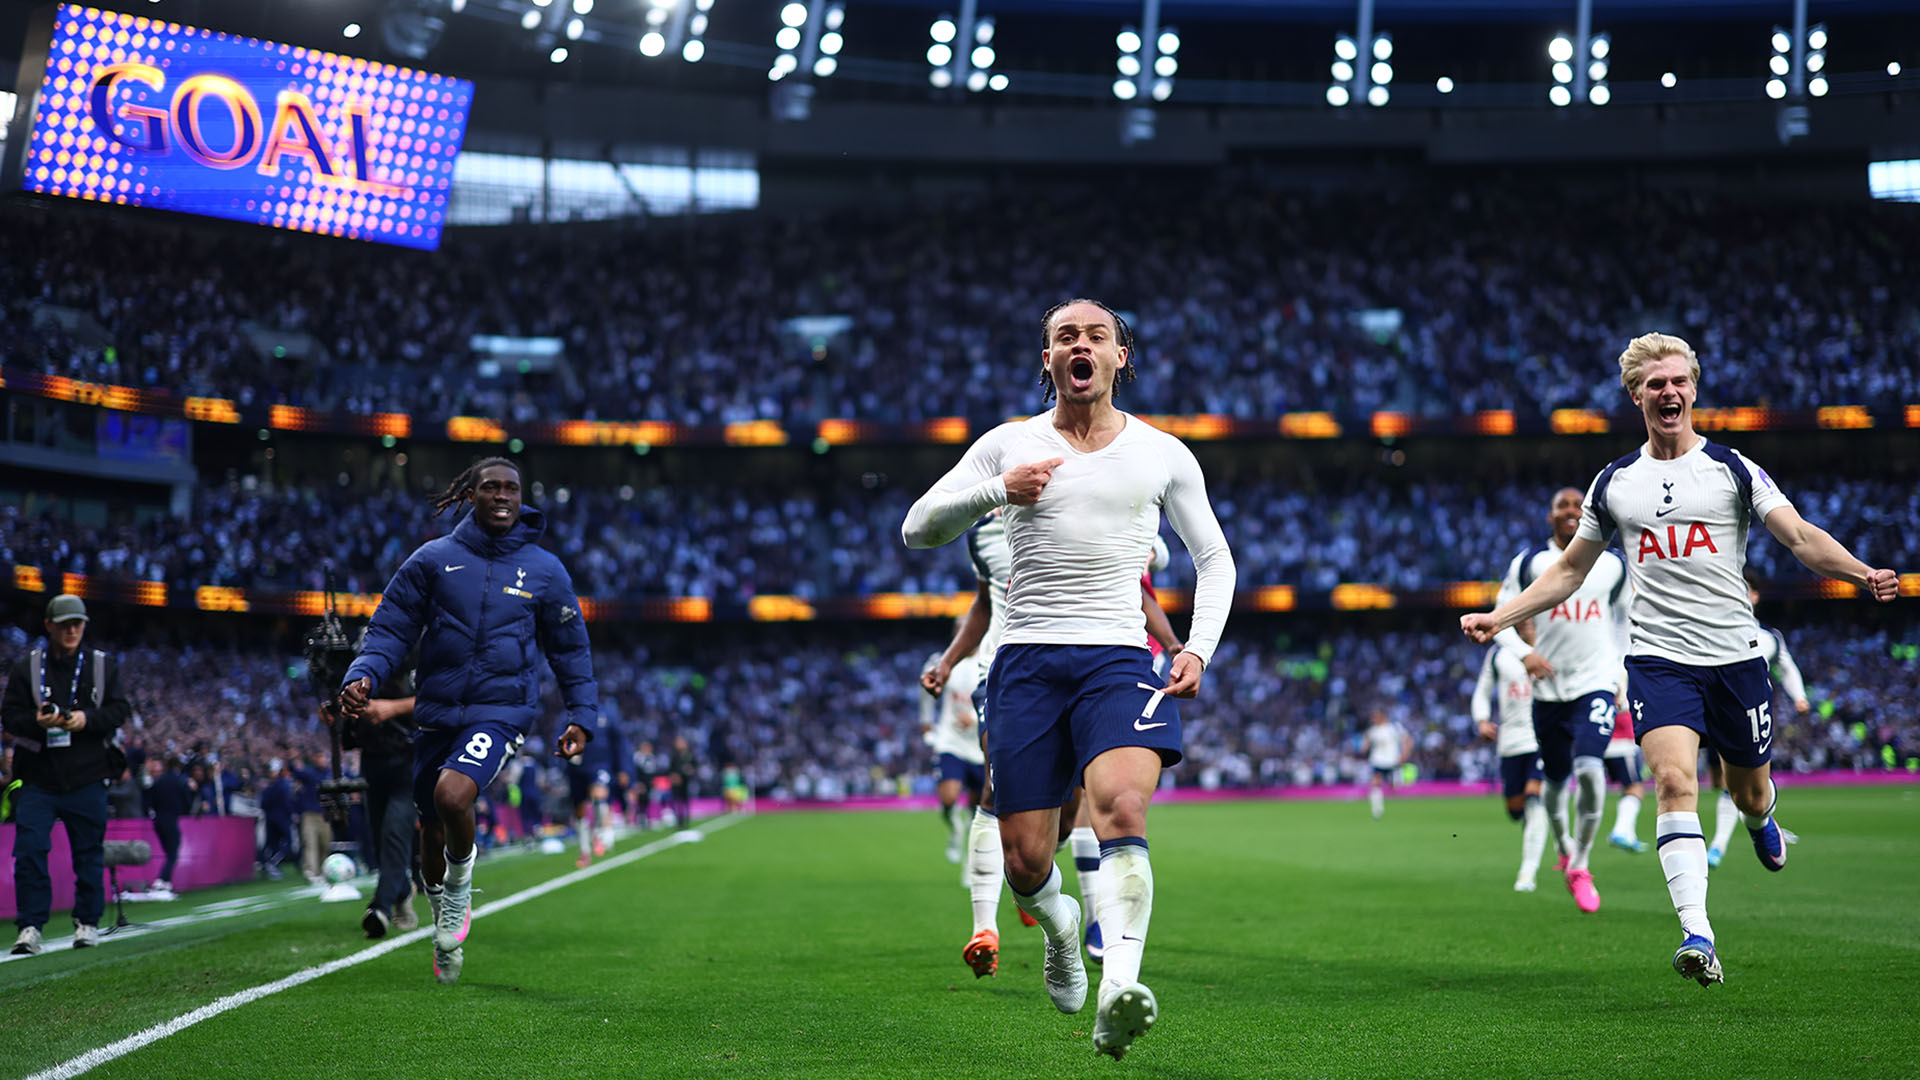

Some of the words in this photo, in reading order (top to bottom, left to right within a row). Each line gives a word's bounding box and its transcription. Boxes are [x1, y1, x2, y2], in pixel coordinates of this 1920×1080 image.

[89, 62, 407, 197] GOAL
[1638, 521, 1718, 563] AIA
[1549, 598, 1602, 622] AIA
[1137, 682, 1166, 719] 7
[1746, 700, 1772, 743] 15
[465, 732, 493, 760] 8
